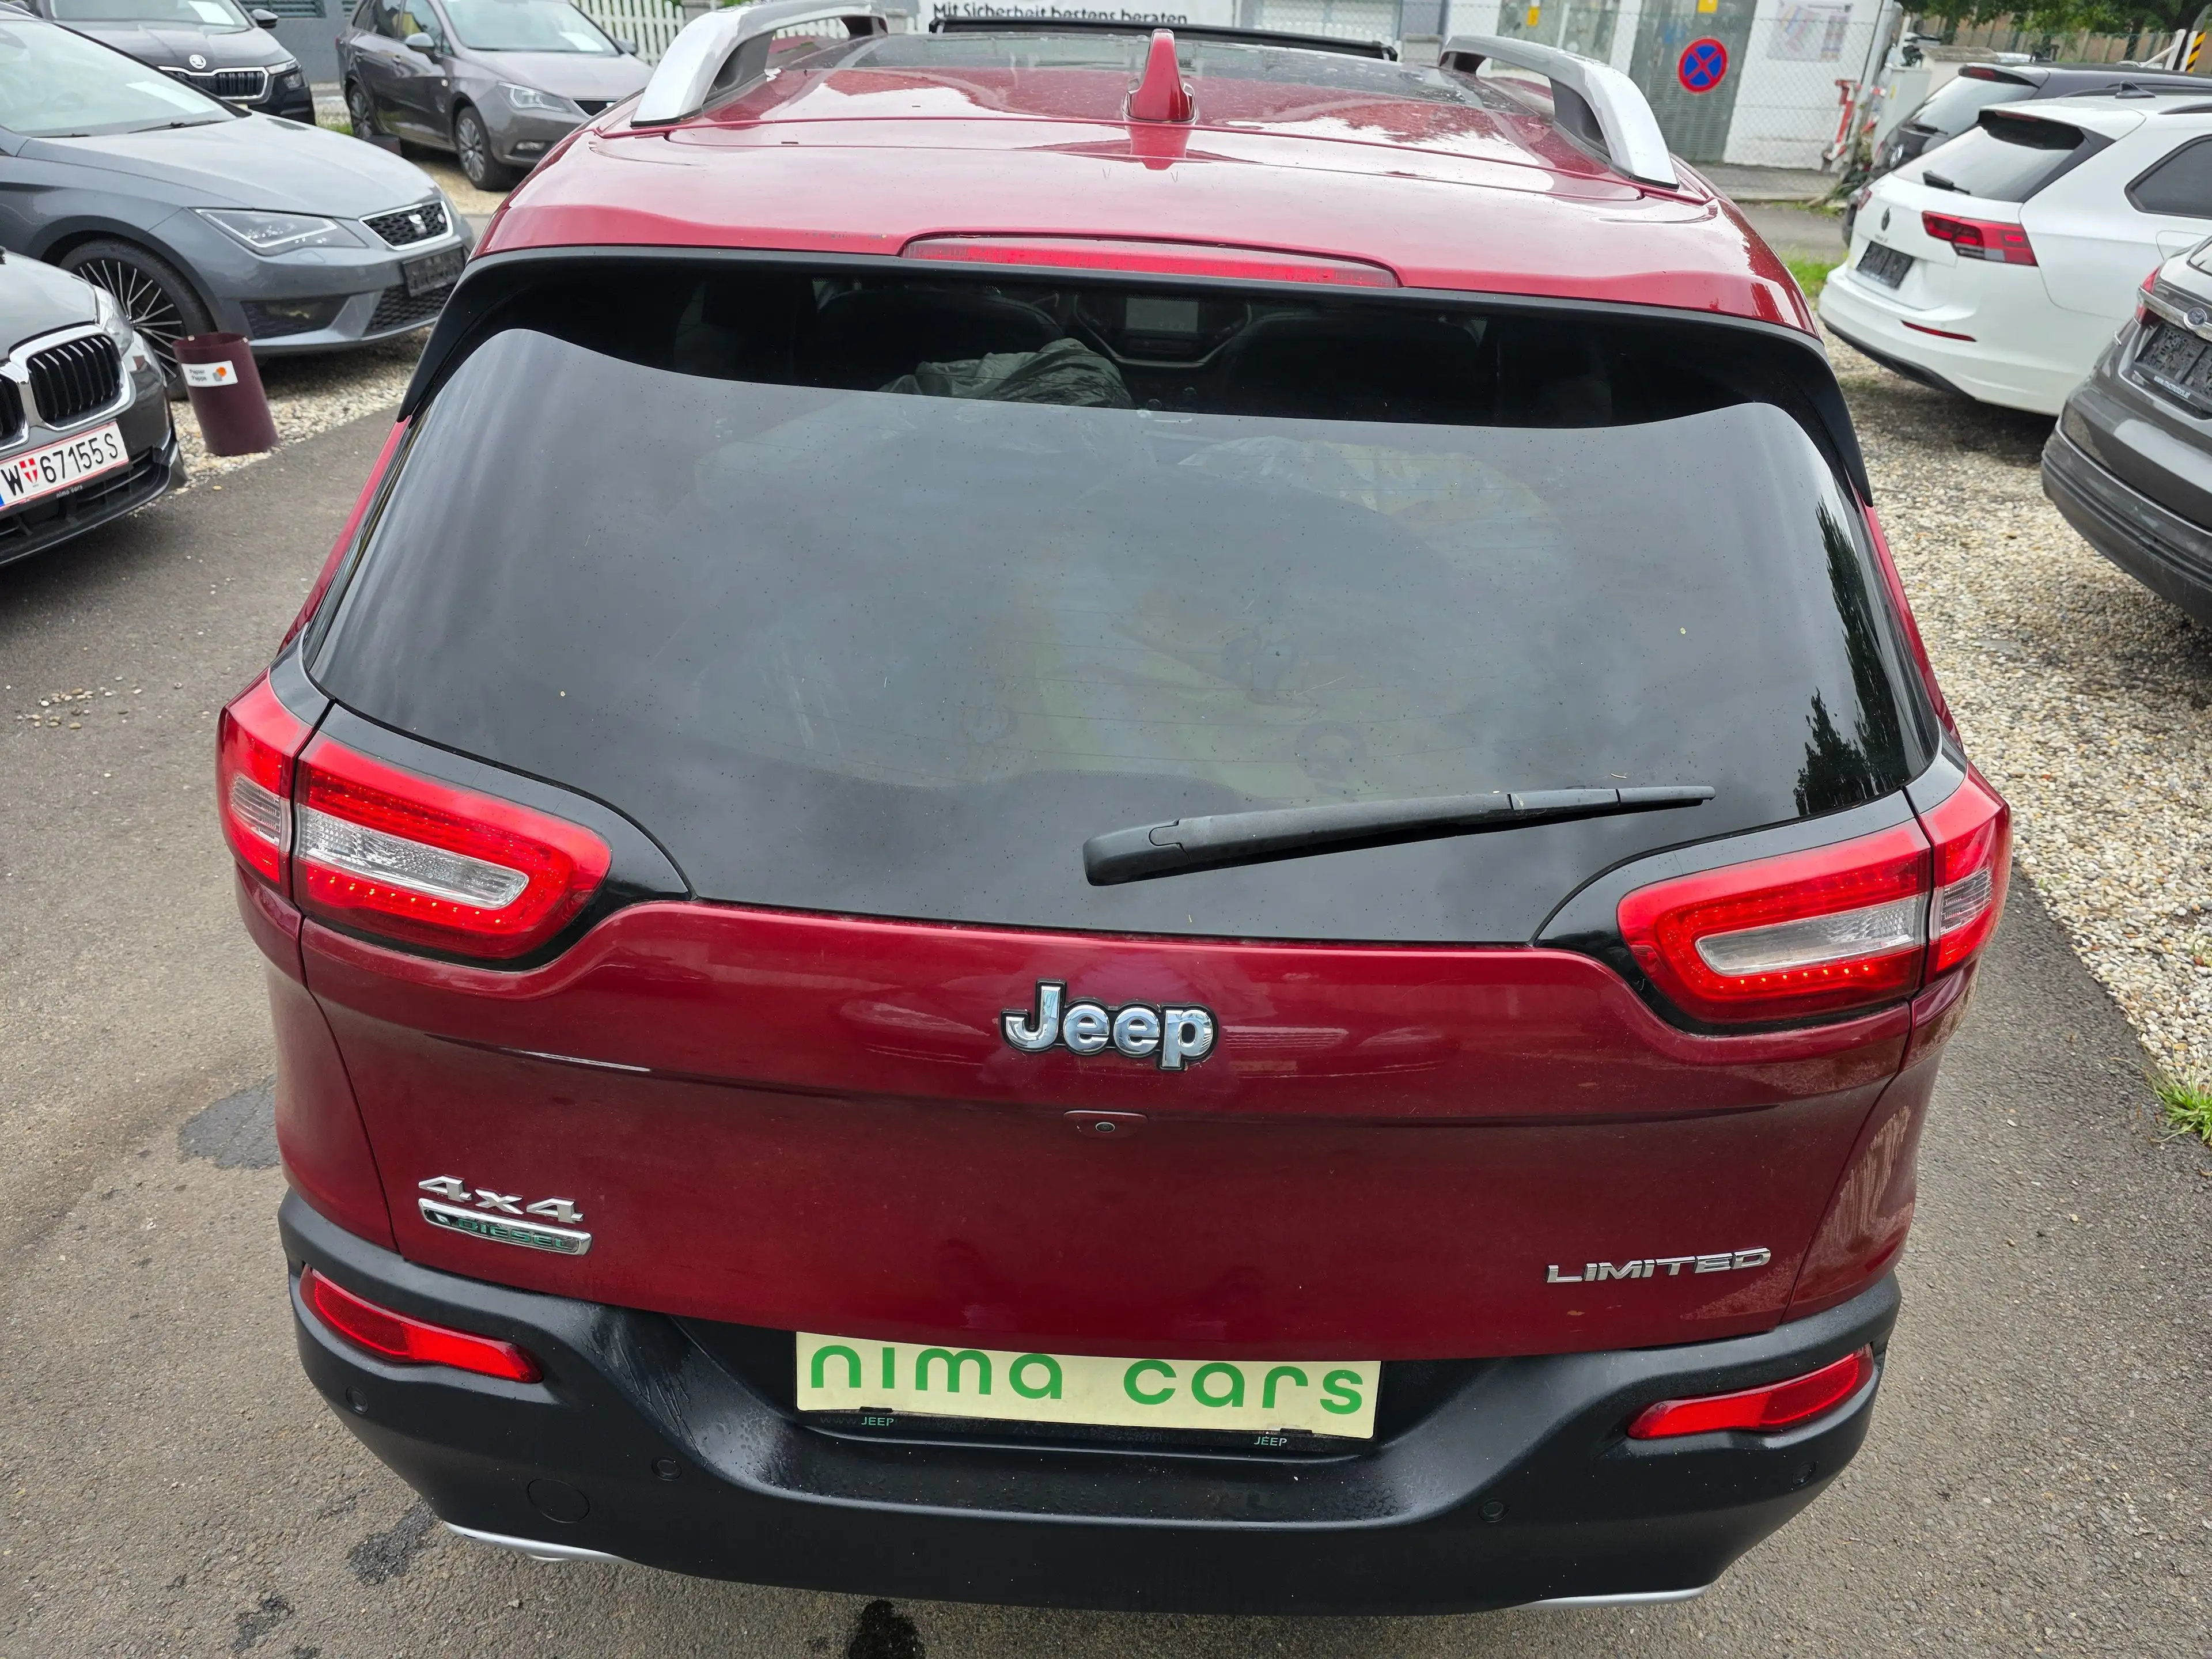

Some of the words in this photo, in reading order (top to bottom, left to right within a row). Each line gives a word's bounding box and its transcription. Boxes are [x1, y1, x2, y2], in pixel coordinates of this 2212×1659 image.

[933, 2, 957, 17] Mit
[964, 2, 1046, 17] Sicherheit
[1051, 6, 1115, 21] bestens
[1121, 9, 1188, 24] beraten
[1, 465, 24, 496] W
[40, 437, 104, 483] 67155
[104, 433, 118, 459] S
[1003, 983, 1215, 1069] Jeep
[1546, 1246, 1771, 1283] LIMITED
[811, 1345, 1063, 1400] nima
[1123, 1359, 1363, 1415] cars
[861, 1416, 895, 1427] JEEP
[1253, 1436, 1288, 1447] JEEP
